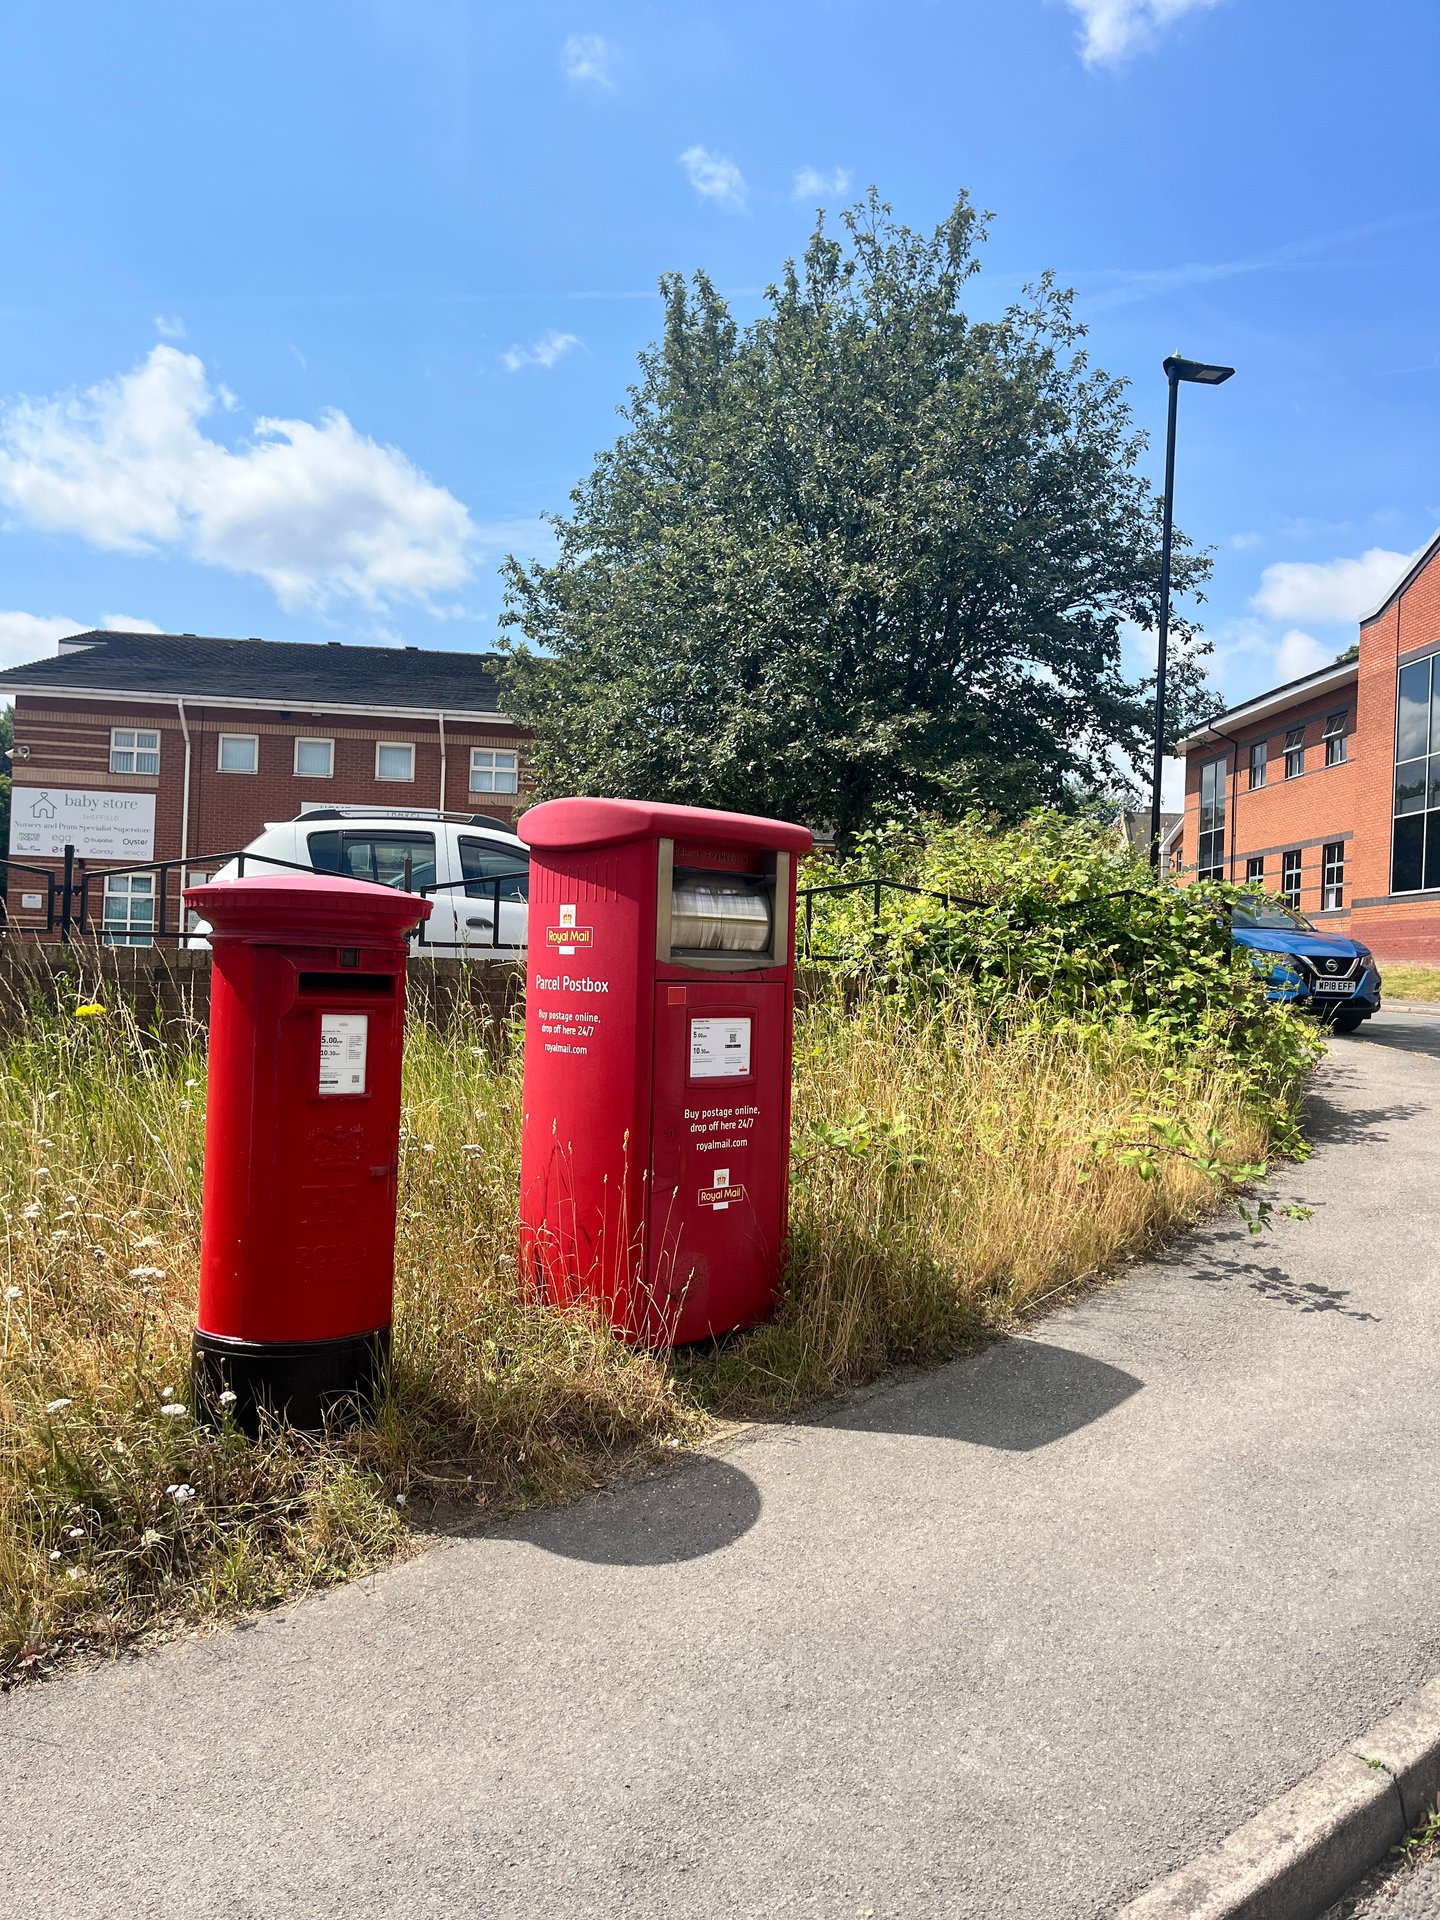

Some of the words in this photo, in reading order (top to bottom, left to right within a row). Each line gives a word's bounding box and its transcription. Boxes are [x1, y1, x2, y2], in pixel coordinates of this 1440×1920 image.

[65, 794, 99, 811] baby
[103, 799, 138, 810] store
[15, 820, 41, 830] Nursery
[79, 824, 112, 832] Specialist
[113, 825, 151, 834] Superstore
[51, 834, 71, 843] egg
[122, 838, 148, 846] Oyster
[548, 930, 569, 944] Royal
[570, 930, 590, 942] Mail
[535, 974, 560, 991] Parcel
[563, 976, 609, 993] Postbox
[1338, 982, 1352, 990] EFF
[538, 1009, 548, 1021] Buy
[549, 1011, 573, 1023] postage
[575, 1012, 601, 1024] online,
[541, 1023, 553, 1034] drop
[553, 1024, 562, 1034] off
[562, 1025, 576, 1035] here
[577, 1026, 594, 1037] 24/7
[544, 1043, 588, 1054] royalmail.com
[684, 1108, 699, 1120] Buy
[702, 1107, 733, 1119] postage
[735, 1105, 760, 1115] online,
[690, 1122, 707, 1133] drop
[708, 1121, 719, 1131] off
[720, 1120, 737, 1130] here
[738, 1118, 754, 1129] 24/7
[696, 1138, 748, 1152] royalmail.com
[701, 1190, 723, 1202] Royal
[724, 1187, 741, 1198] Mail
